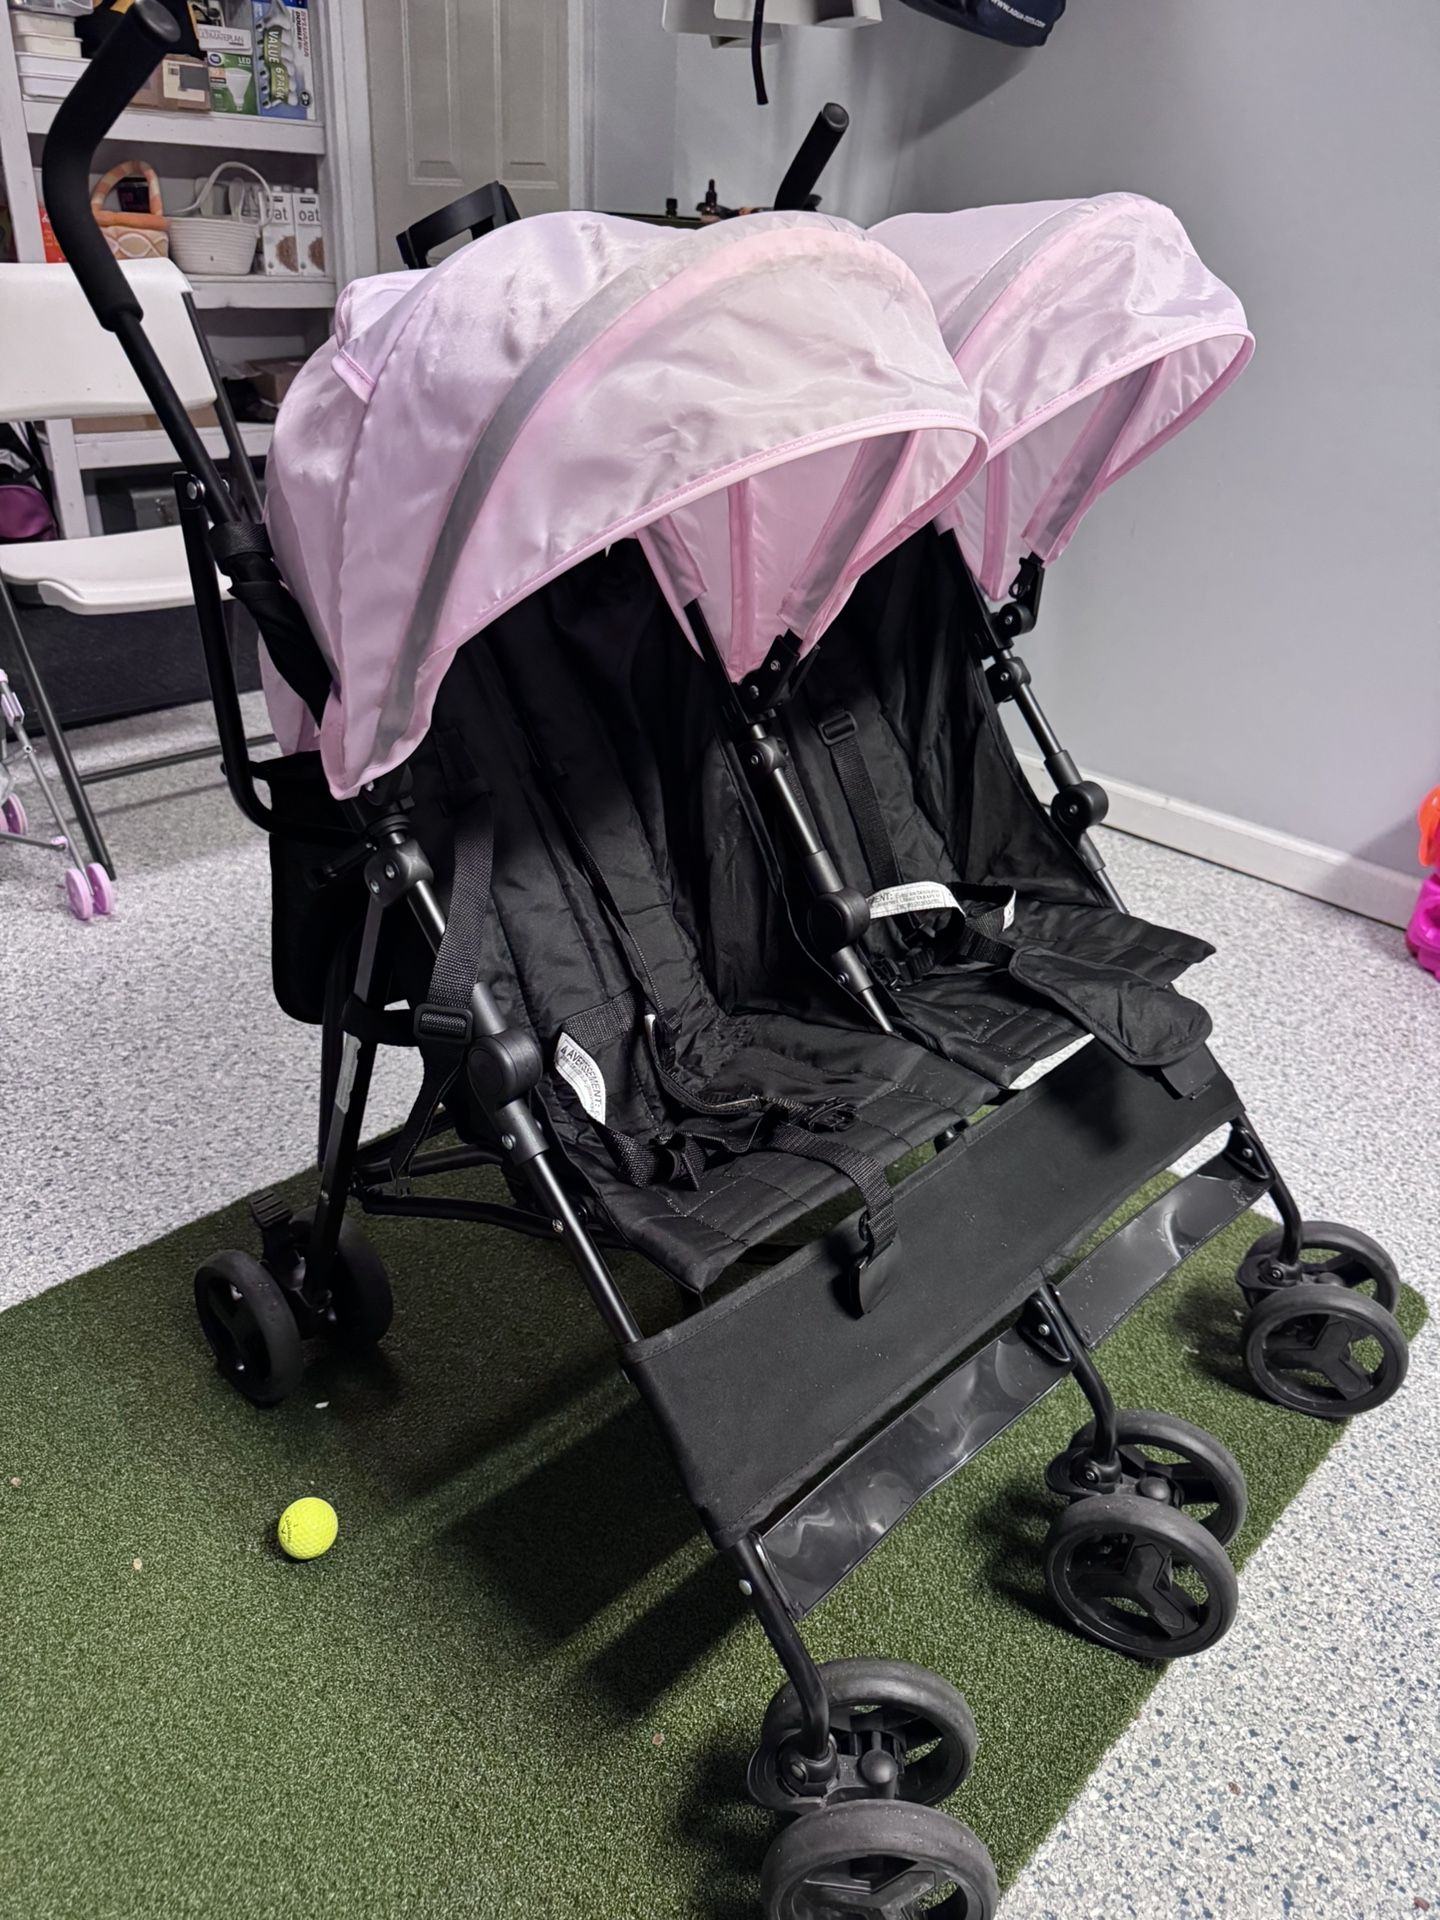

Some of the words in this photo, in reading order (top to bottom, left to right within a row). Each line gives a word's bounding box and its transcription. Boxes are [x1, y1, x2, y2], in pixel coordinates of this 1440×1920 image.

[238, 57, 251, 65] LED
[268, 31, 280, 63] VALUE
[276, 74, 285, 99] PACK
[299, 208, 320, 222] oat
